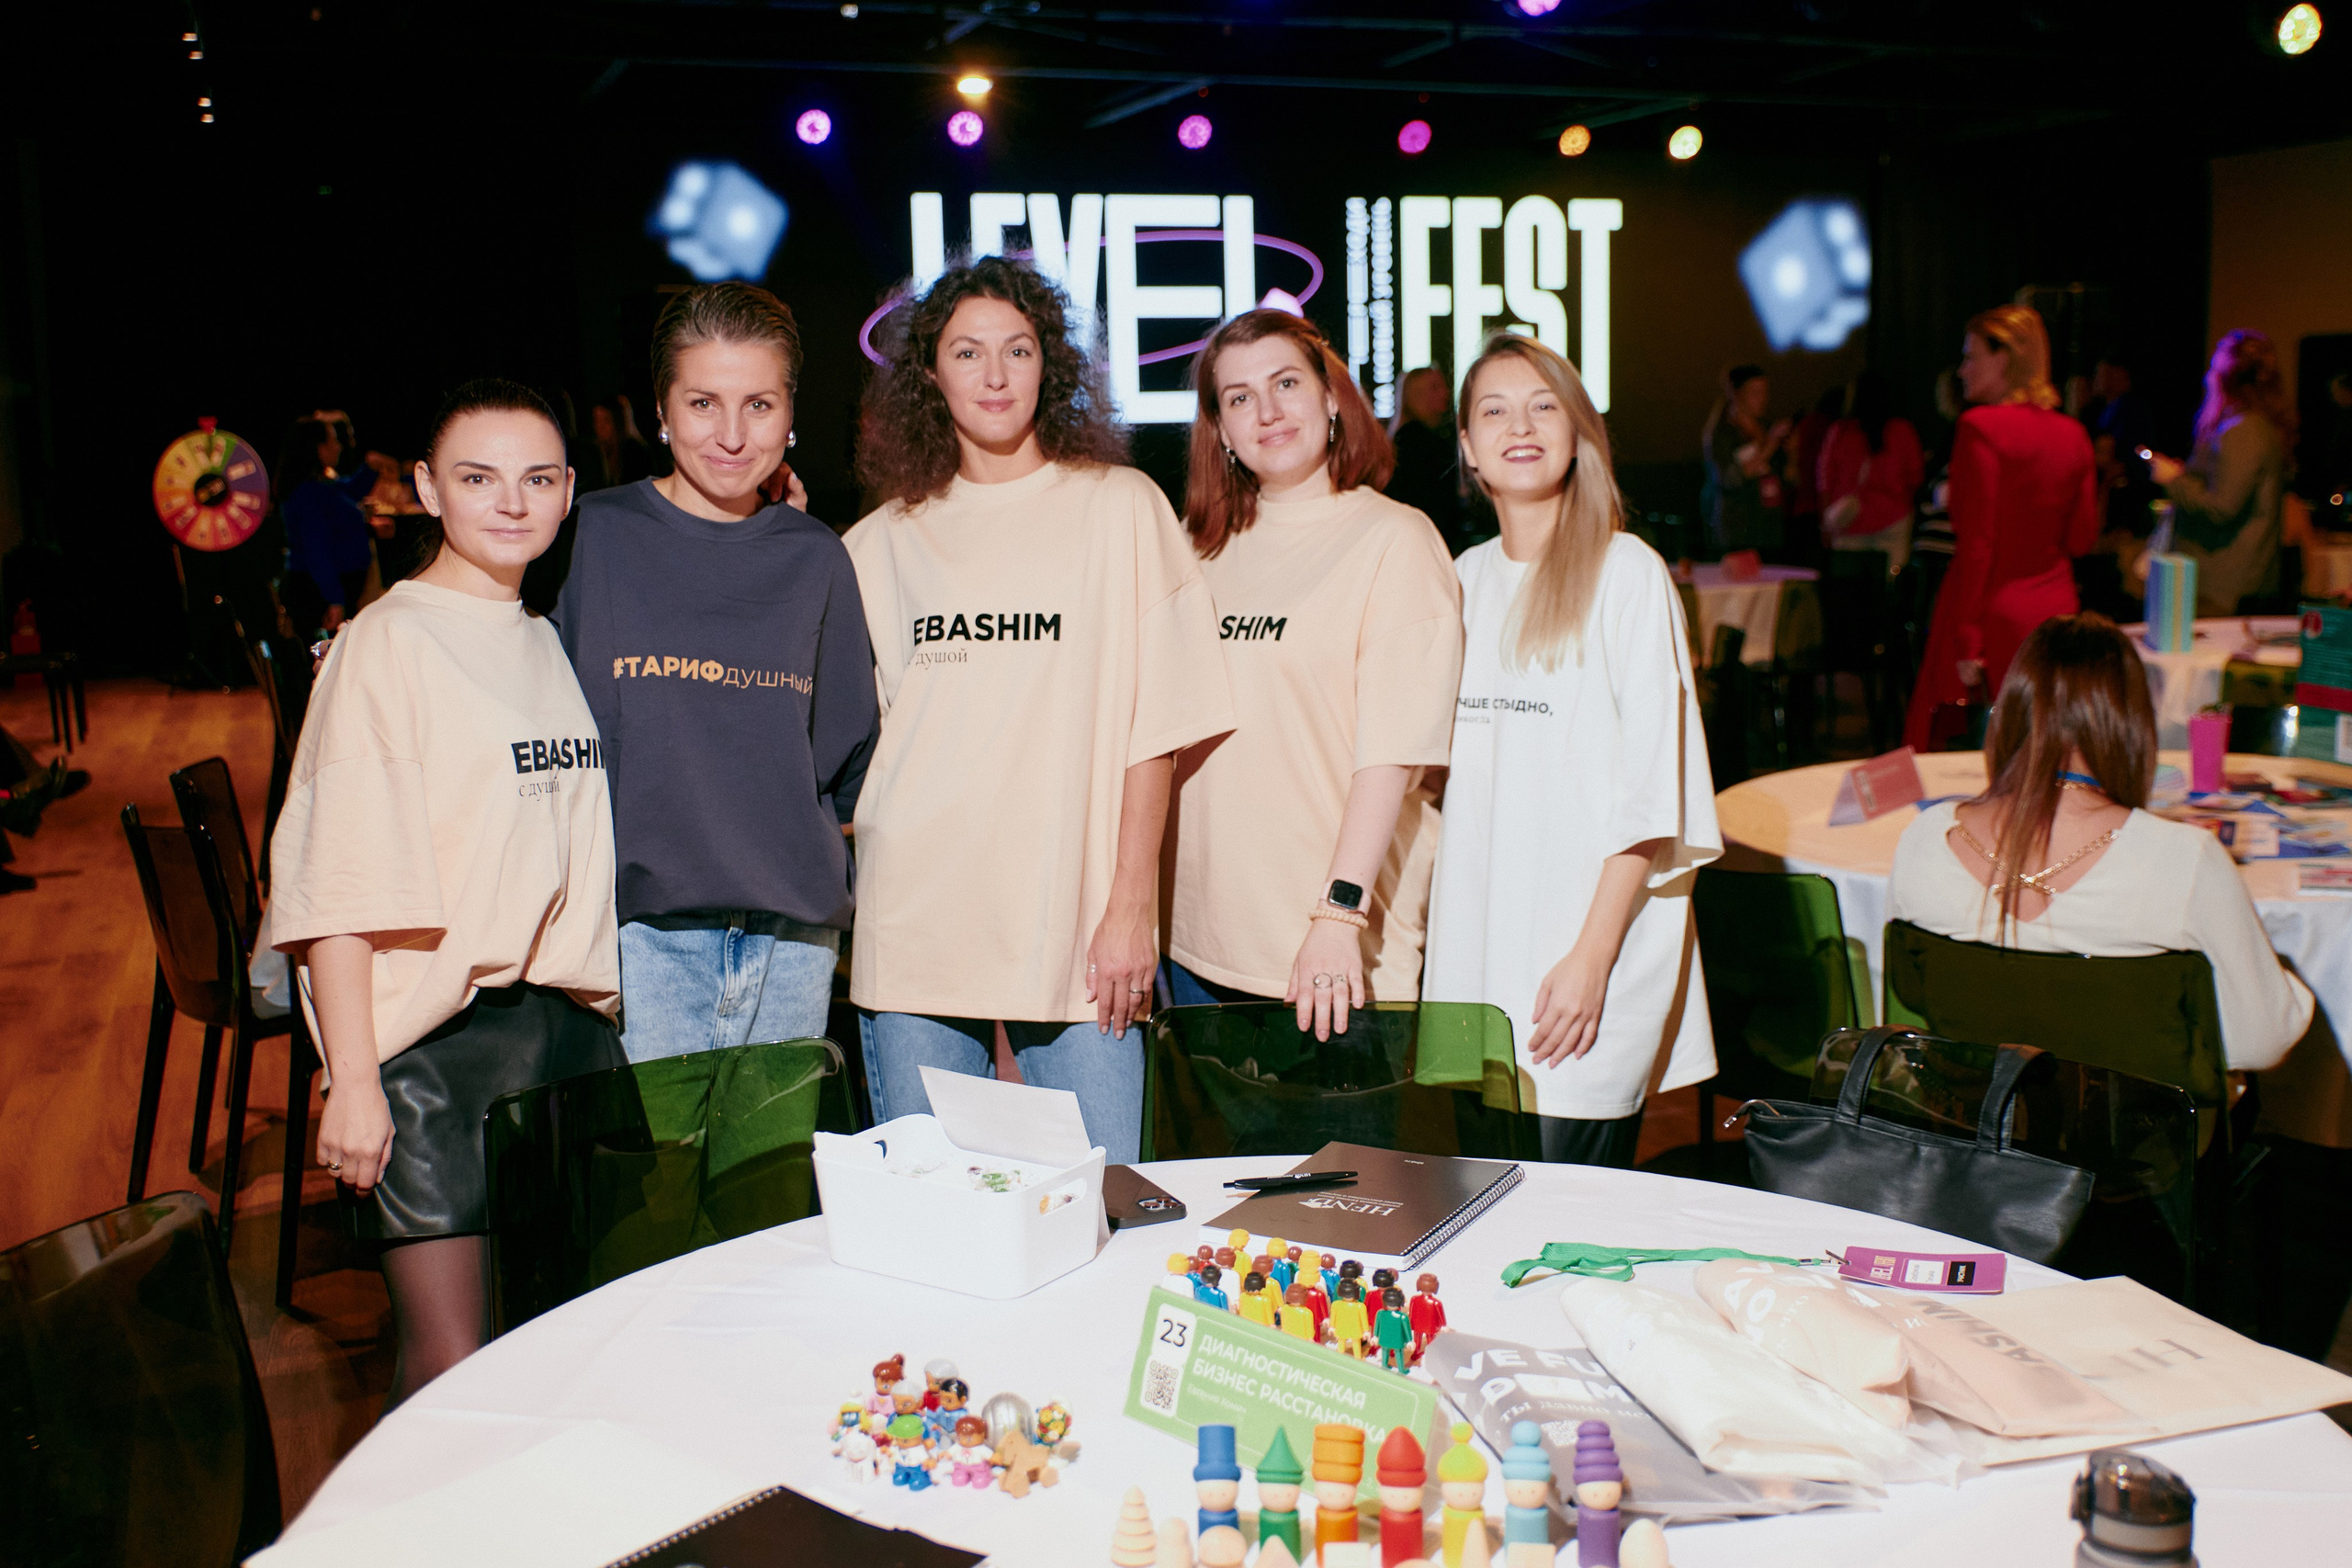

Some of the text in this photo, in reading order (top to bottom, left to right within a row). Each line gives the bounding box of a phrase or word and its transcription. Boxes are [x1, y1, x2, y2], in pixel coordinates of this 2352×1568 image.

[1399, 195, 1624, 414] FEST
[913, 613, 1061, 648] EBASHIM
[1219, 615, 1288, 641] SHIM
[915, 647, 968, 670] душой
[1159, 1318, 1189, 1348] 23
[1193, 1358, 1259, 1397] БИЗНЕС
[1198, 1334, 1367, 1410] ДИАГНОСТИЧЕСКАЯ
